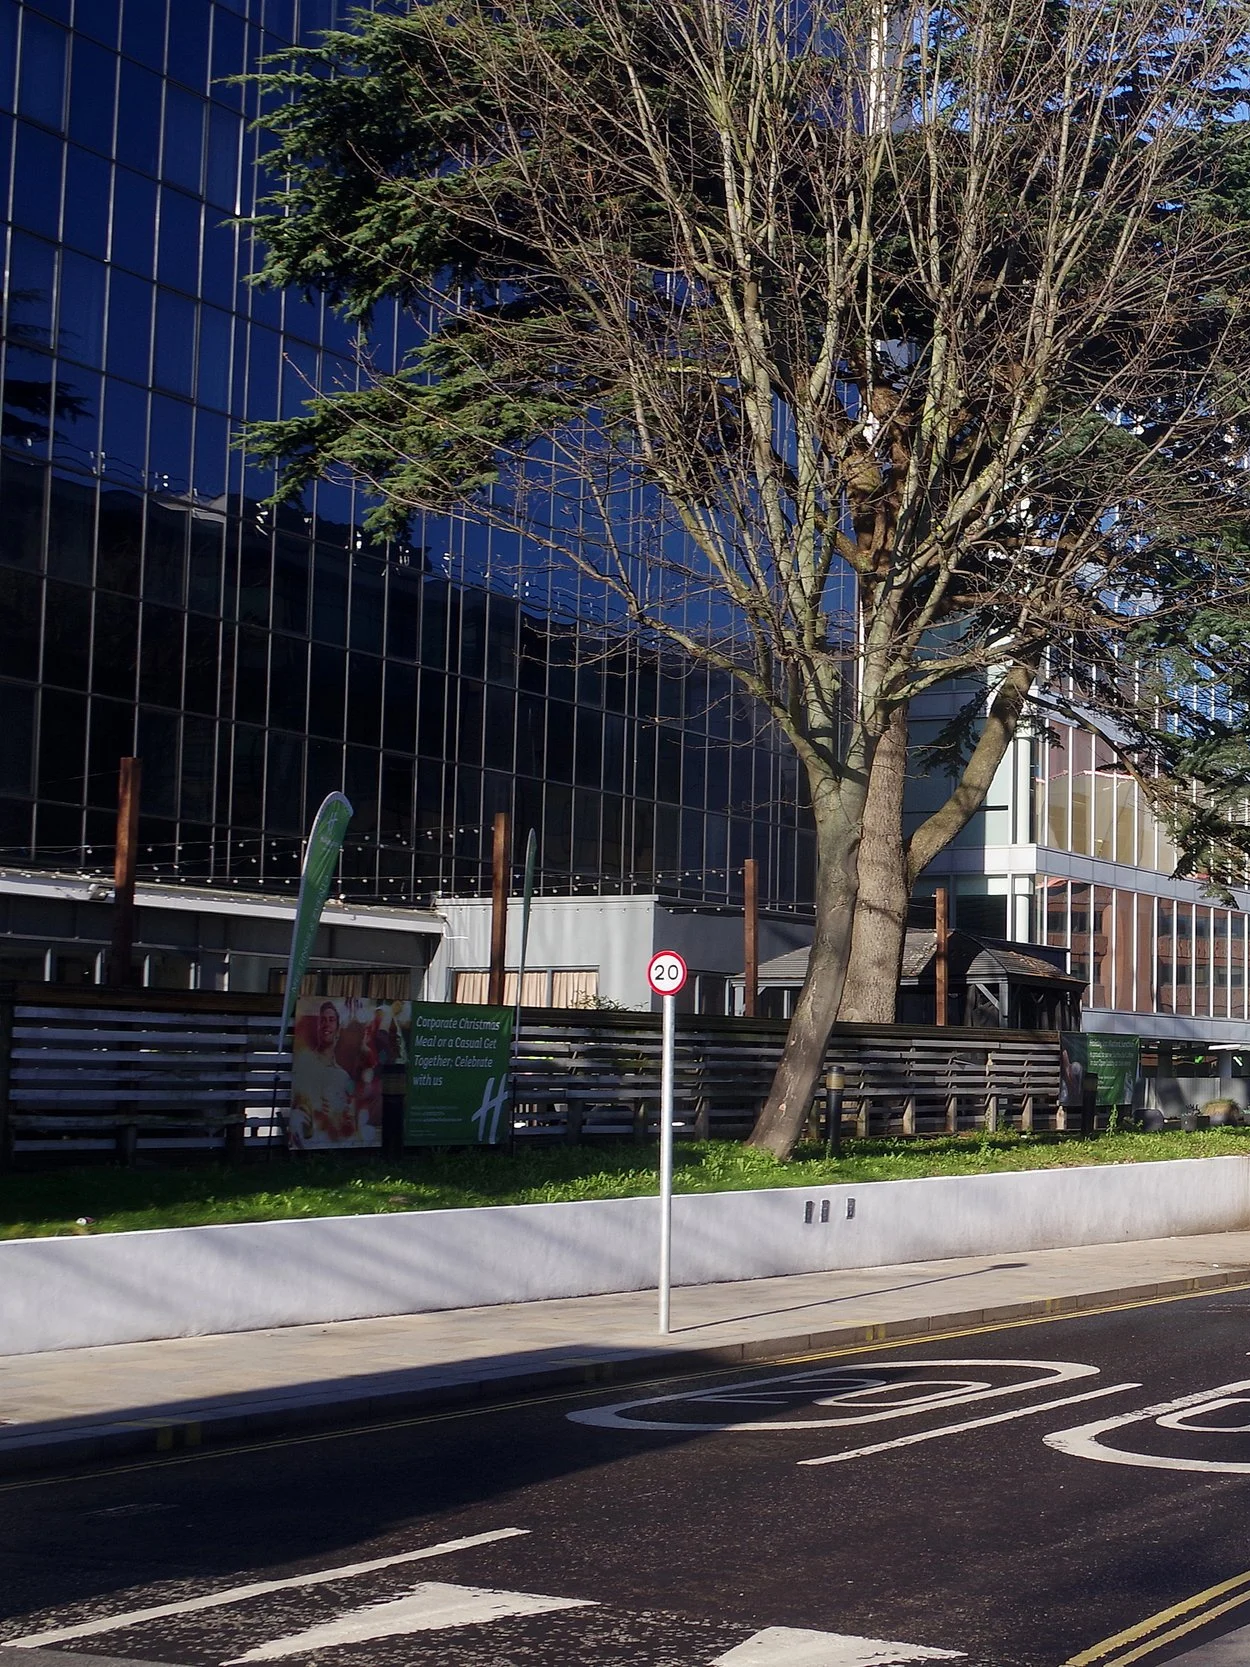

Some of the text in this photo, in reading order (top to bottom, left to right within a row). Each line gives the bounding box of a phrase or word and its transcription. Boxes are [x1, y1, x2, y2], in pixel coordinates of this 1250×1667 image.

[654, 964, 679, 980] 20
[416, 1015, 500, 1031] Corporate Christmas
[415, 1035, 437, 1047] Meal
[437, 1040, 447, 1048] or
[455, 1036, 483, 1049] Casual
[483, 1038, 497, 1049] Get
[454, 1055, 493, 1068] Celebrate
[413, 1073, 443, 1086] with us
